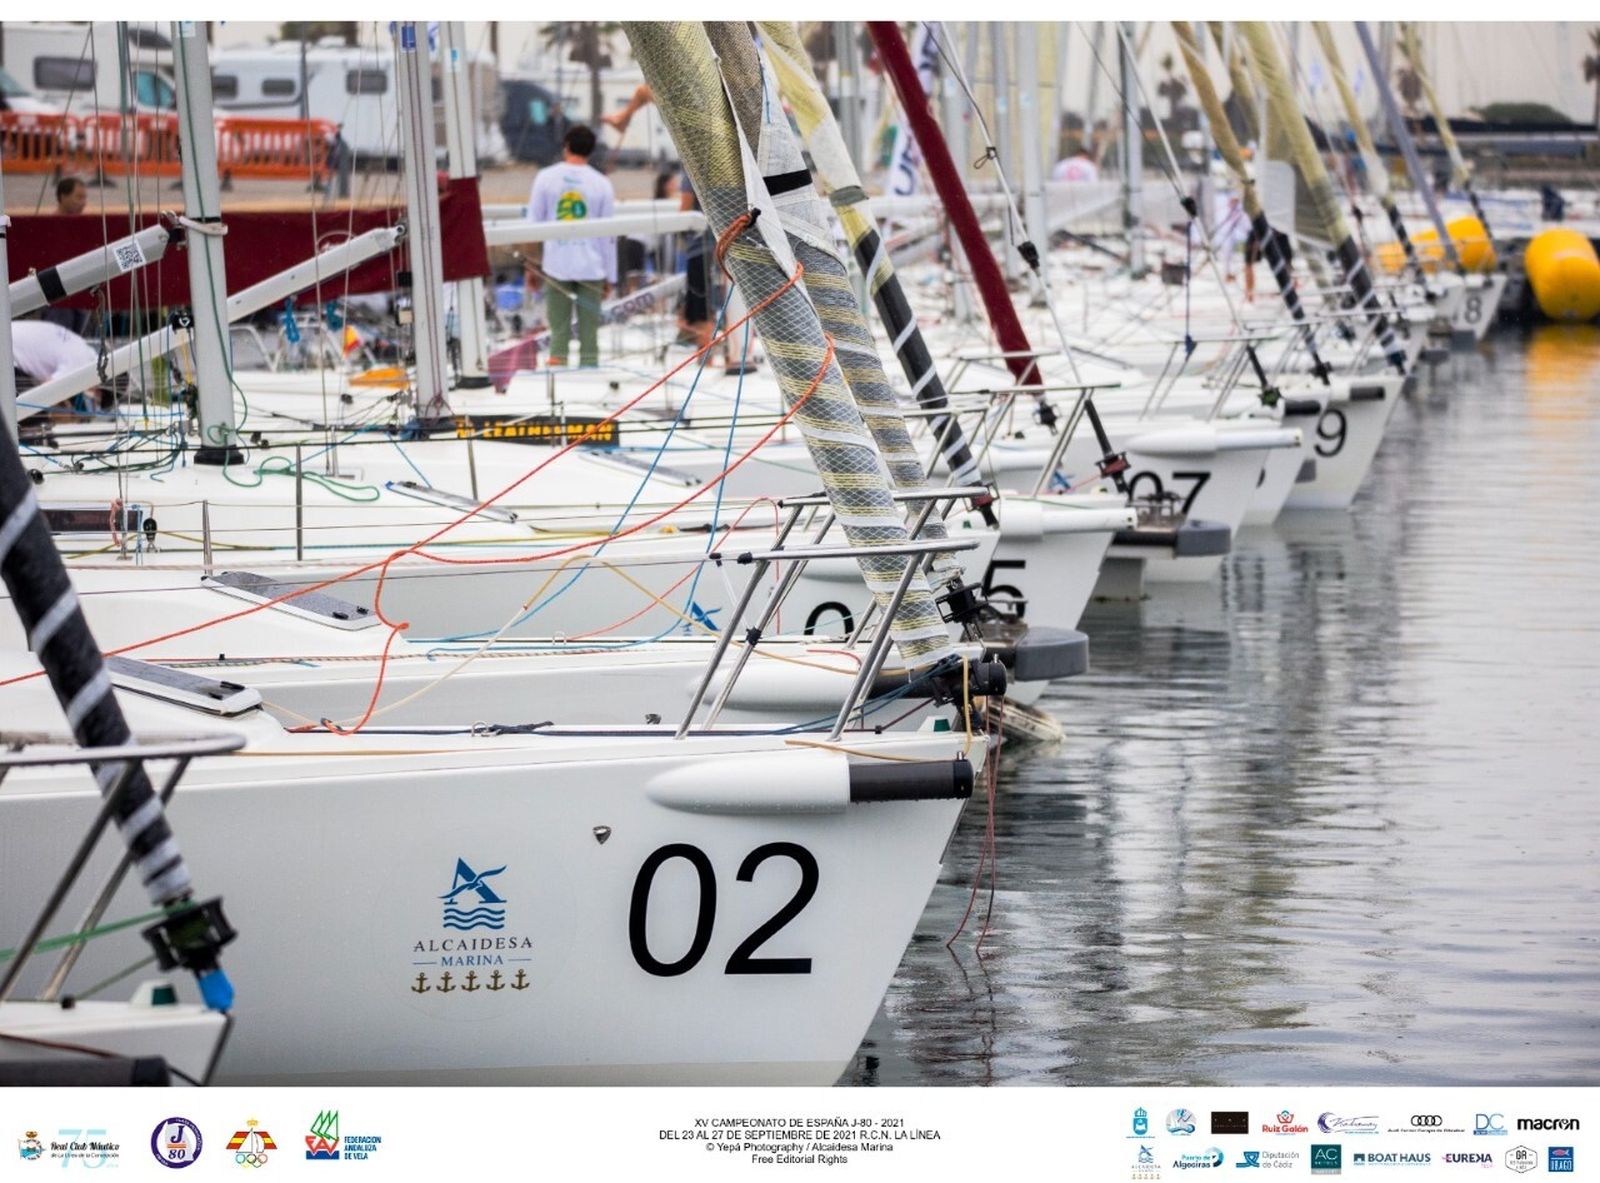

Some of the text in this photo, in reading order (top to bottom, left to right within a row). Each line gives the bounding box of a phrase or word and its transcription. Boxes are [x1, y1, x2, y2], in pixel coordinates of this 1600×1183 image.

[1314, 408, 1347, 458] 9
[981, 559, 1026, 619] 5
[628, 841, 820, 977] 02
[412, 935, 534, 953] ALCAIDESA
[441, 953, 505, 968] MARINA
